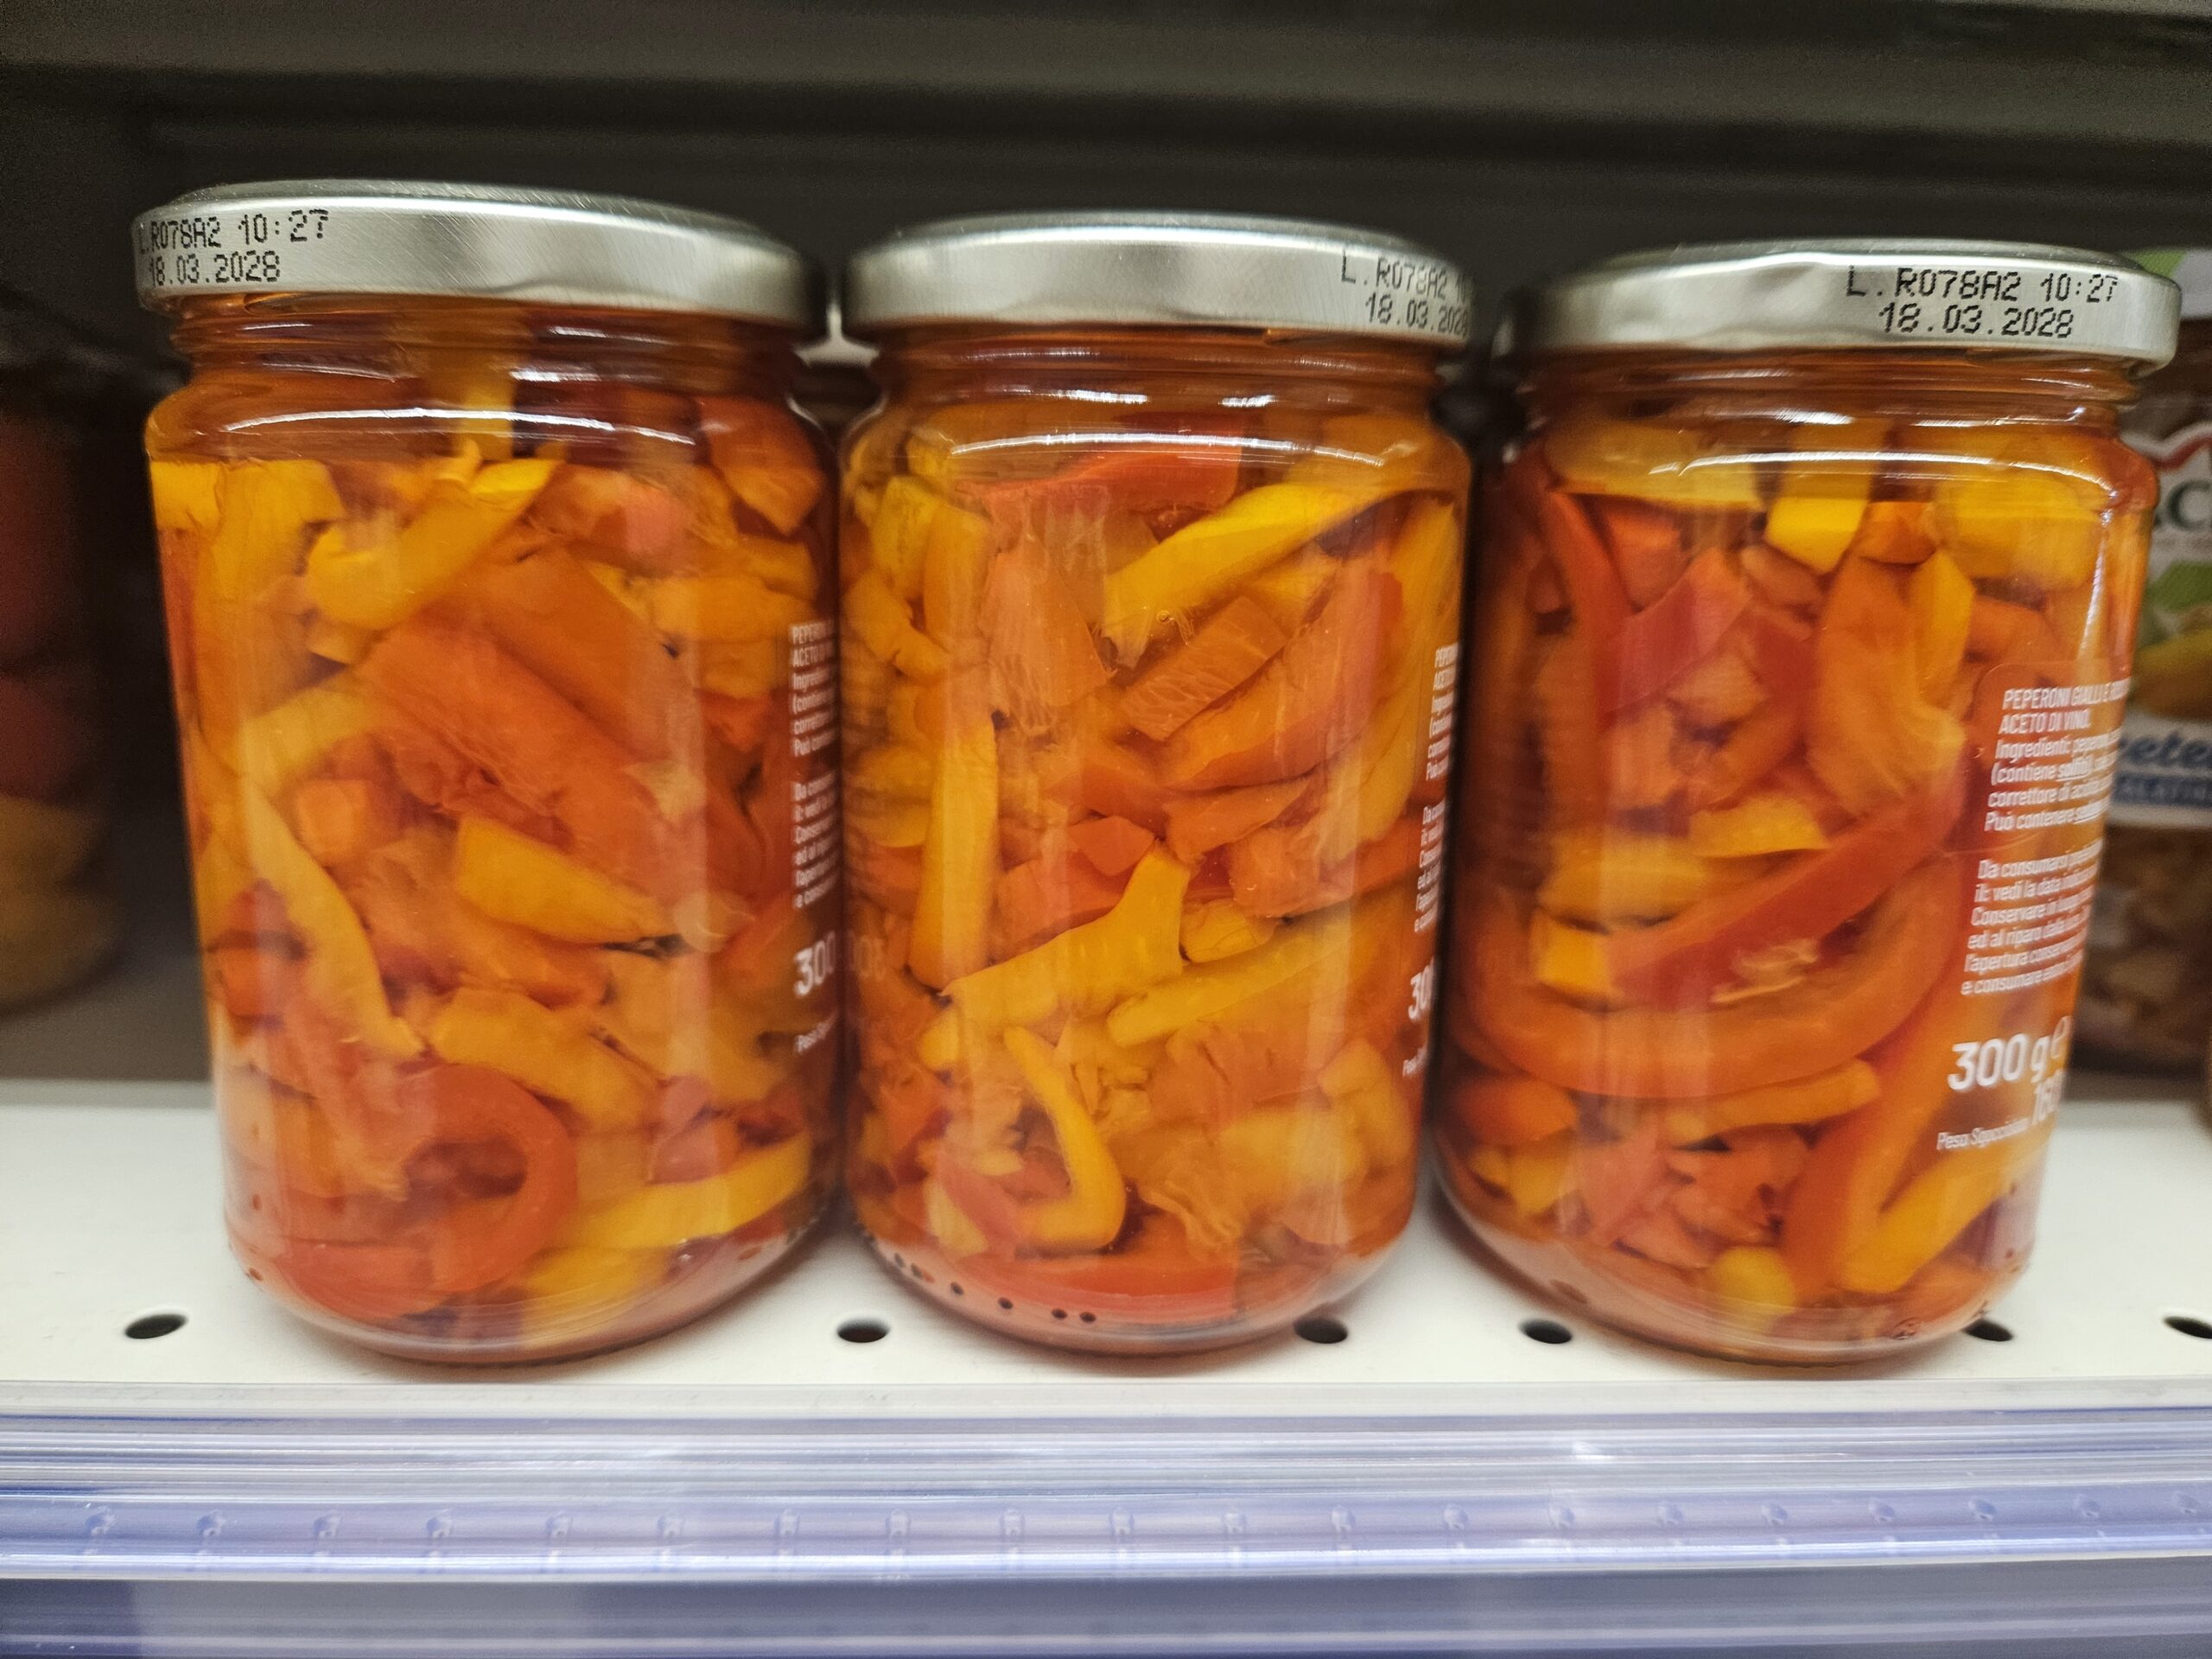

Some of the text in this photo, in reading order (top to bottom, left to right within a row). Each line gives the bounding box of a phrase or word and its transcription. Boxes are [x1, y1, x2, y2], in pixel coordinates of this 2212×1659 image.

[238, 208, 329, 245] 10:27
[149, 250, 281, 288] 18.03.2028
[1341, 250, 1448, 301] L.R078A2
[1845, 265, 2119, 304] L.R078A2 10:27
[1878, 302, 2074, 339] 18.03.2028
[2001, 685, 2072, 710] PEPERONI
[1998, 712, 2048, 735] ACETO
[2048, 712, 2063, 734] DI
[1994, 734, 2071, 763] Ingredienti:
[1991, 760, 2056, 785] (contiene
[1988, 788, 2057, 808] correttore
[1984, 810, 2016, 831] Può
[1977, 859, 2001, 880] Da
[1993, 880, 2024, 900] vedi
[2024, 880, 2037, 899] la
[1971, 904, 2046, 926] Conservare
[1967, 931, 1991, 950] ed
[1990, 927, 2006, 947] al
[1963, 953, 2031, 975] l'apertura
[1961, 982, 1974, 995] e
[1947, 1032, 2031, 1093] 300
[2031, 1035, 2051, 1084] g
[1936, 1132, 1968, 1151] Peso
